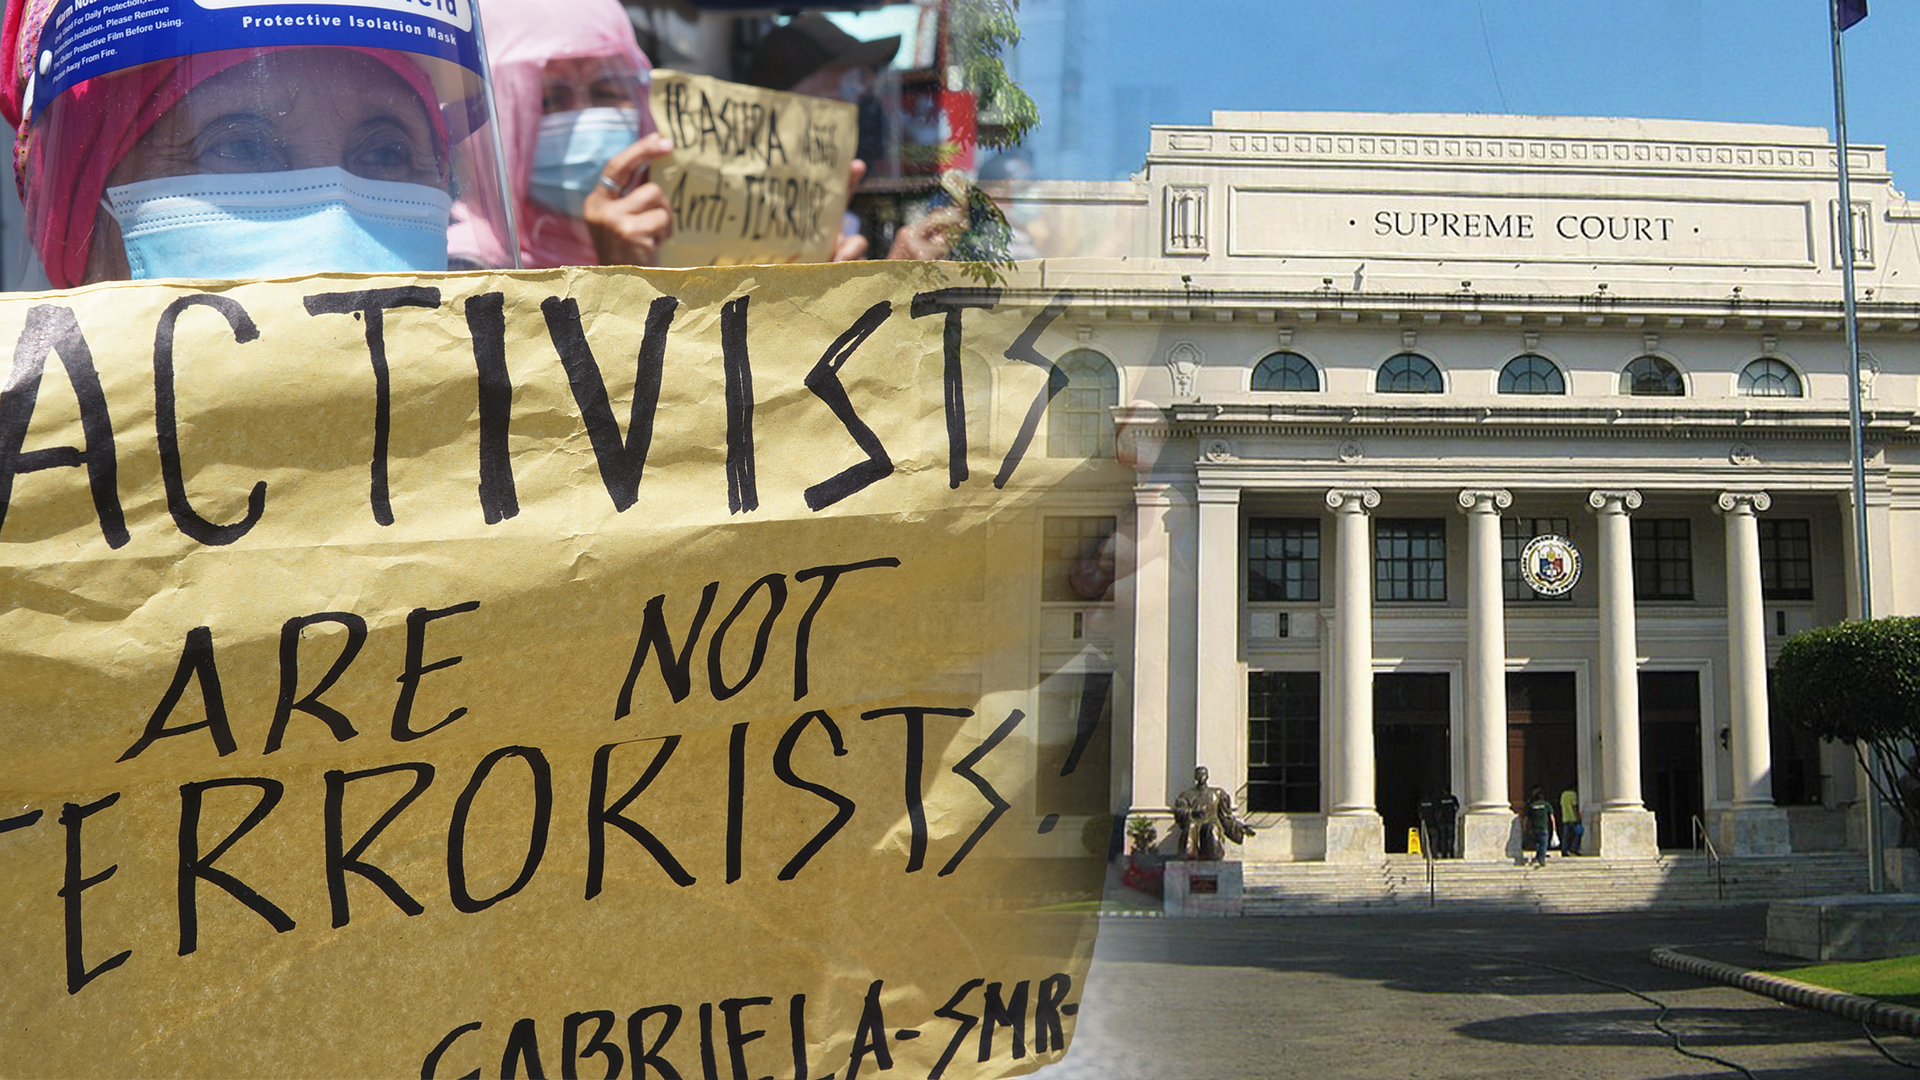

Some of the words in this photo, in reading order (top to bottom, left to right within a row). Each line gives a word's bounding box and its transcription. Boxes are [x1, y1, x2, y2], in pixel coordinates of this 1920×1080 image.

[55, 5, 73, 29] Warm
[74, 17, 84, 26] For
[84, 9, 102, 21] Daily
[106, 14, 133, 28] Please
[134, 6, 170, 20] Remove
[242, 14, 342, 28] Protective
[349, 15, 422, 36] Isolation
[426, 26, 457, 46] Mask
[73, 38, 106, 55] Protective
[107, 30, 124, 43] Film
[125, 21, 154, 37] Before
[155, 18, 185, 30] Using.
[66, 60, 81, 74] Away
[81, 53, 100, 65] From
[100, 48, 118, 59] Fire.
[1374, 211, 1534, 239] SUPREME
[1556, 215, 1675, 241] COURT
[0, 285, 1073, 550] ACTIVISTS
[115, 600, 481, 763] ARE
[614, 557, 901, 721] NOT
